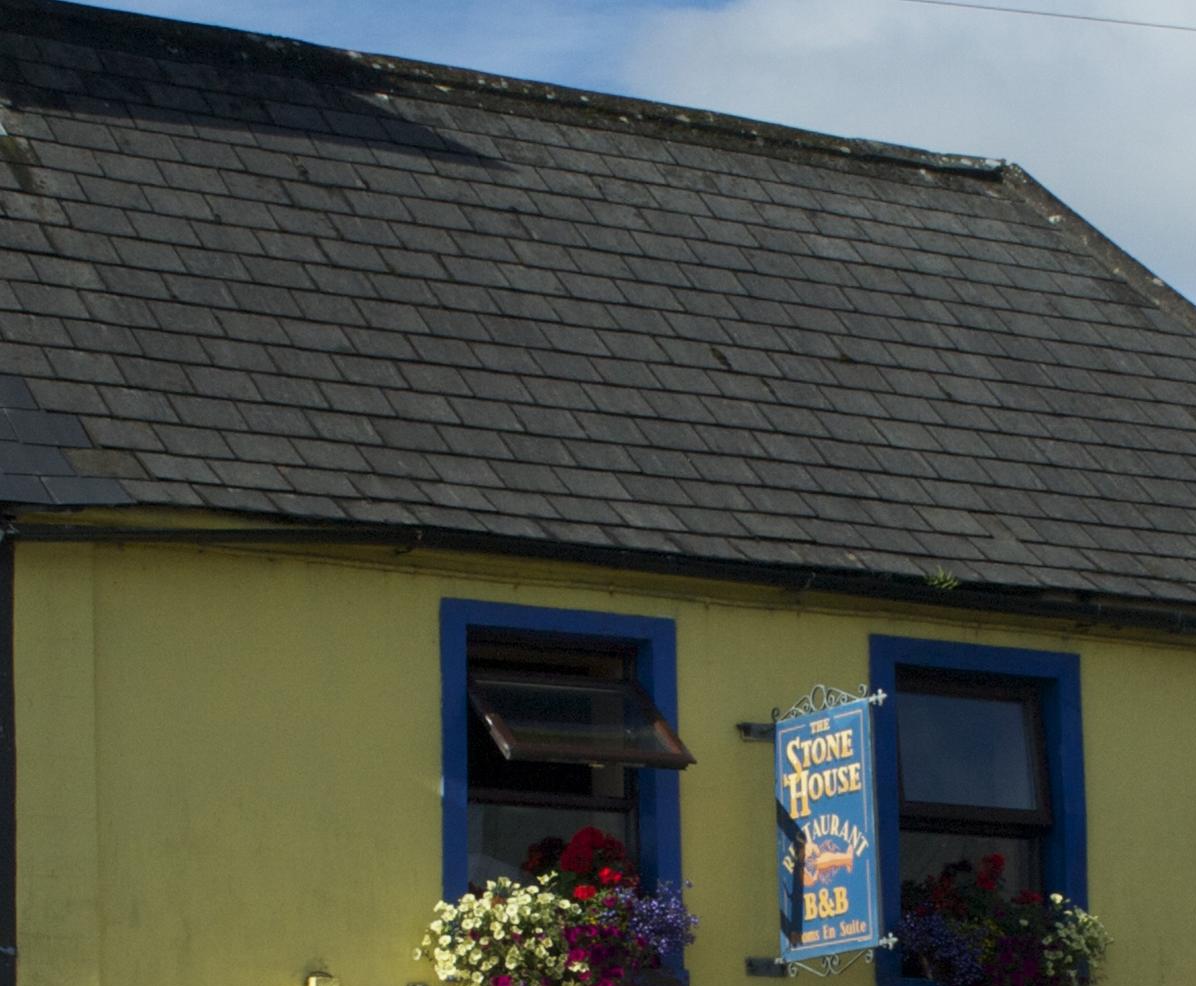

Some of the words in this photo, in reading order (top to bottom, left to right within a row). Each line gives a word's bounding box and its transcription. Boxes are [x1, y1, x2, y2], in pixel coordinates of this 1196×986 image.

[810, 718, 830, 734] THE
[787, 729, 853, 776] STONE
[783, 762, 861, 819] HOUSE
[803, 886, 850, 921] B&B
[840, 919, 867, 936] Suite
